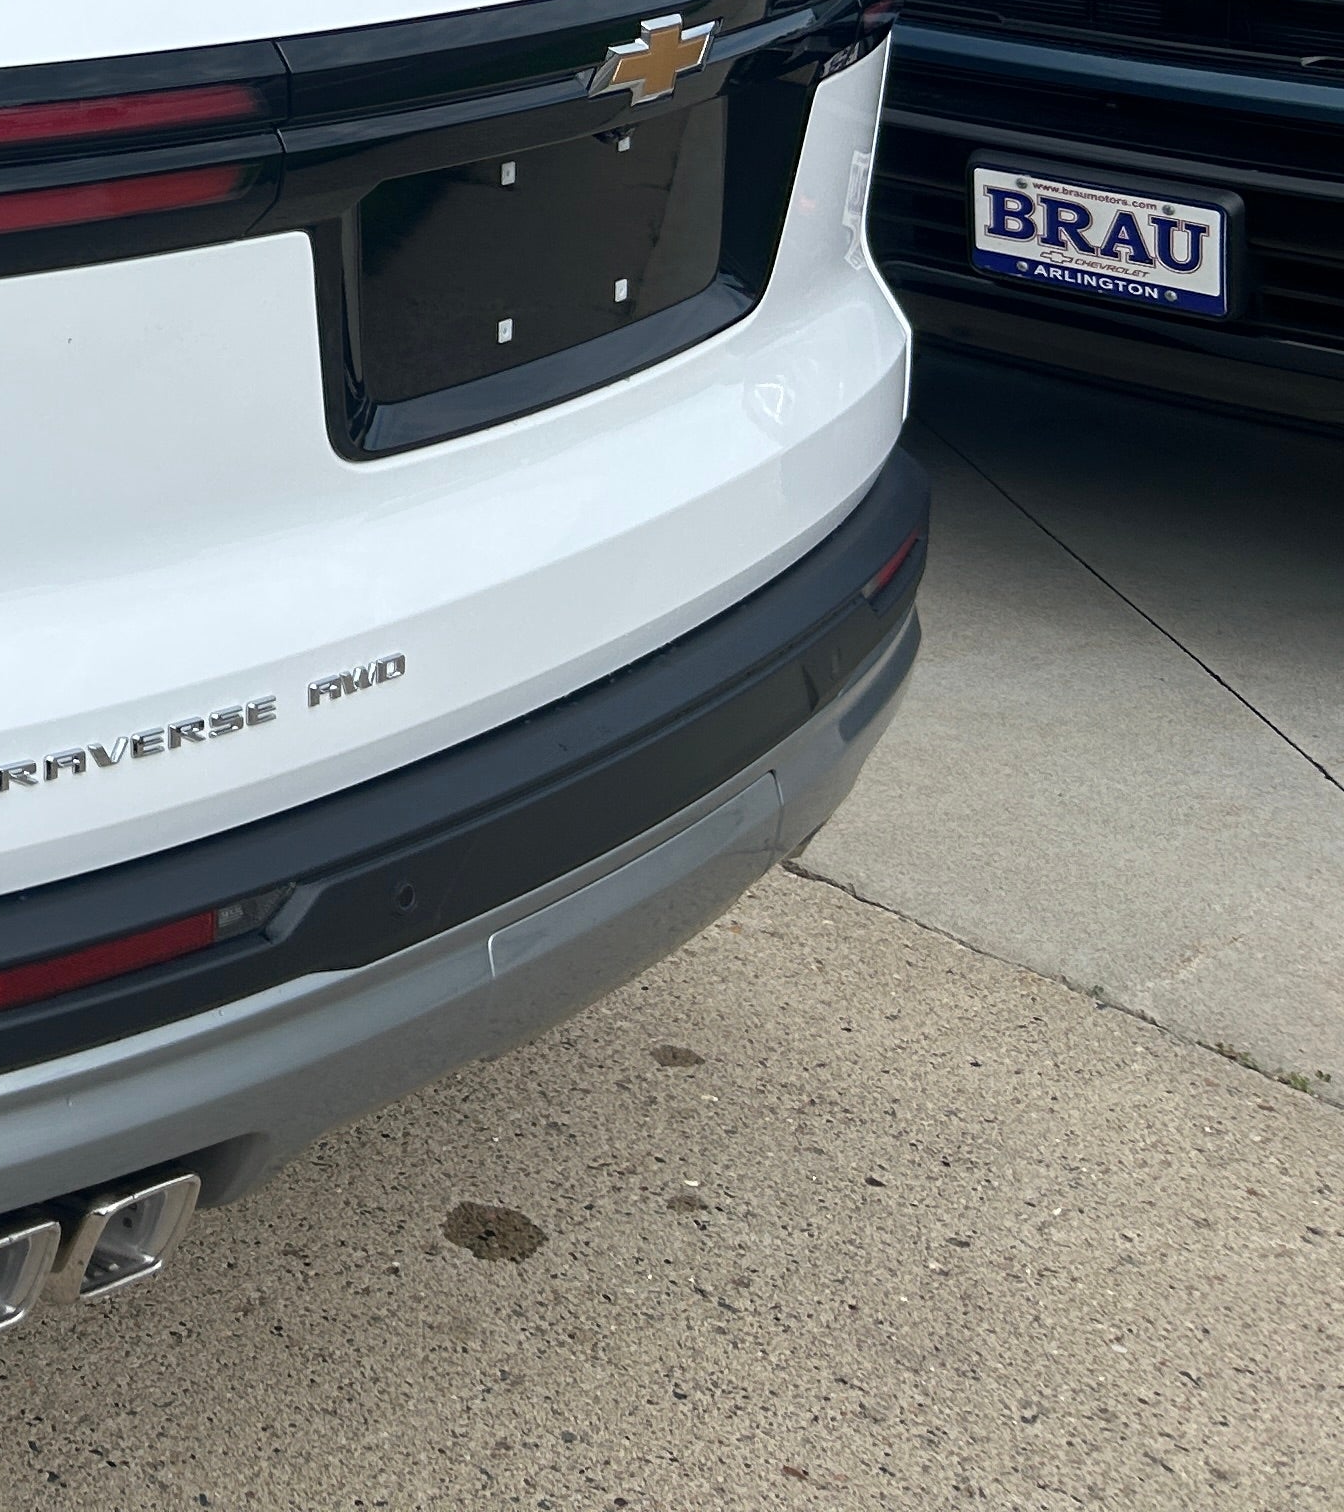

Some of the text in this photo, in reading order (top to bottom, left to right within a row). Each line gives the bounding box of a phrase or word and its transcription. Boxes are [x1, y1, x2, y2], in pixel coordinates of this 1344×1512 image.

[1033, 181, 1157, 211] www.braumotors.com
[983, 184, 1210, 275] BRAU
[1034, 264, 1159, 299] ARLINGTON
[1075, 258, 1150, 278] CHEVROLET
[307, 651, 406, 708] AWD
